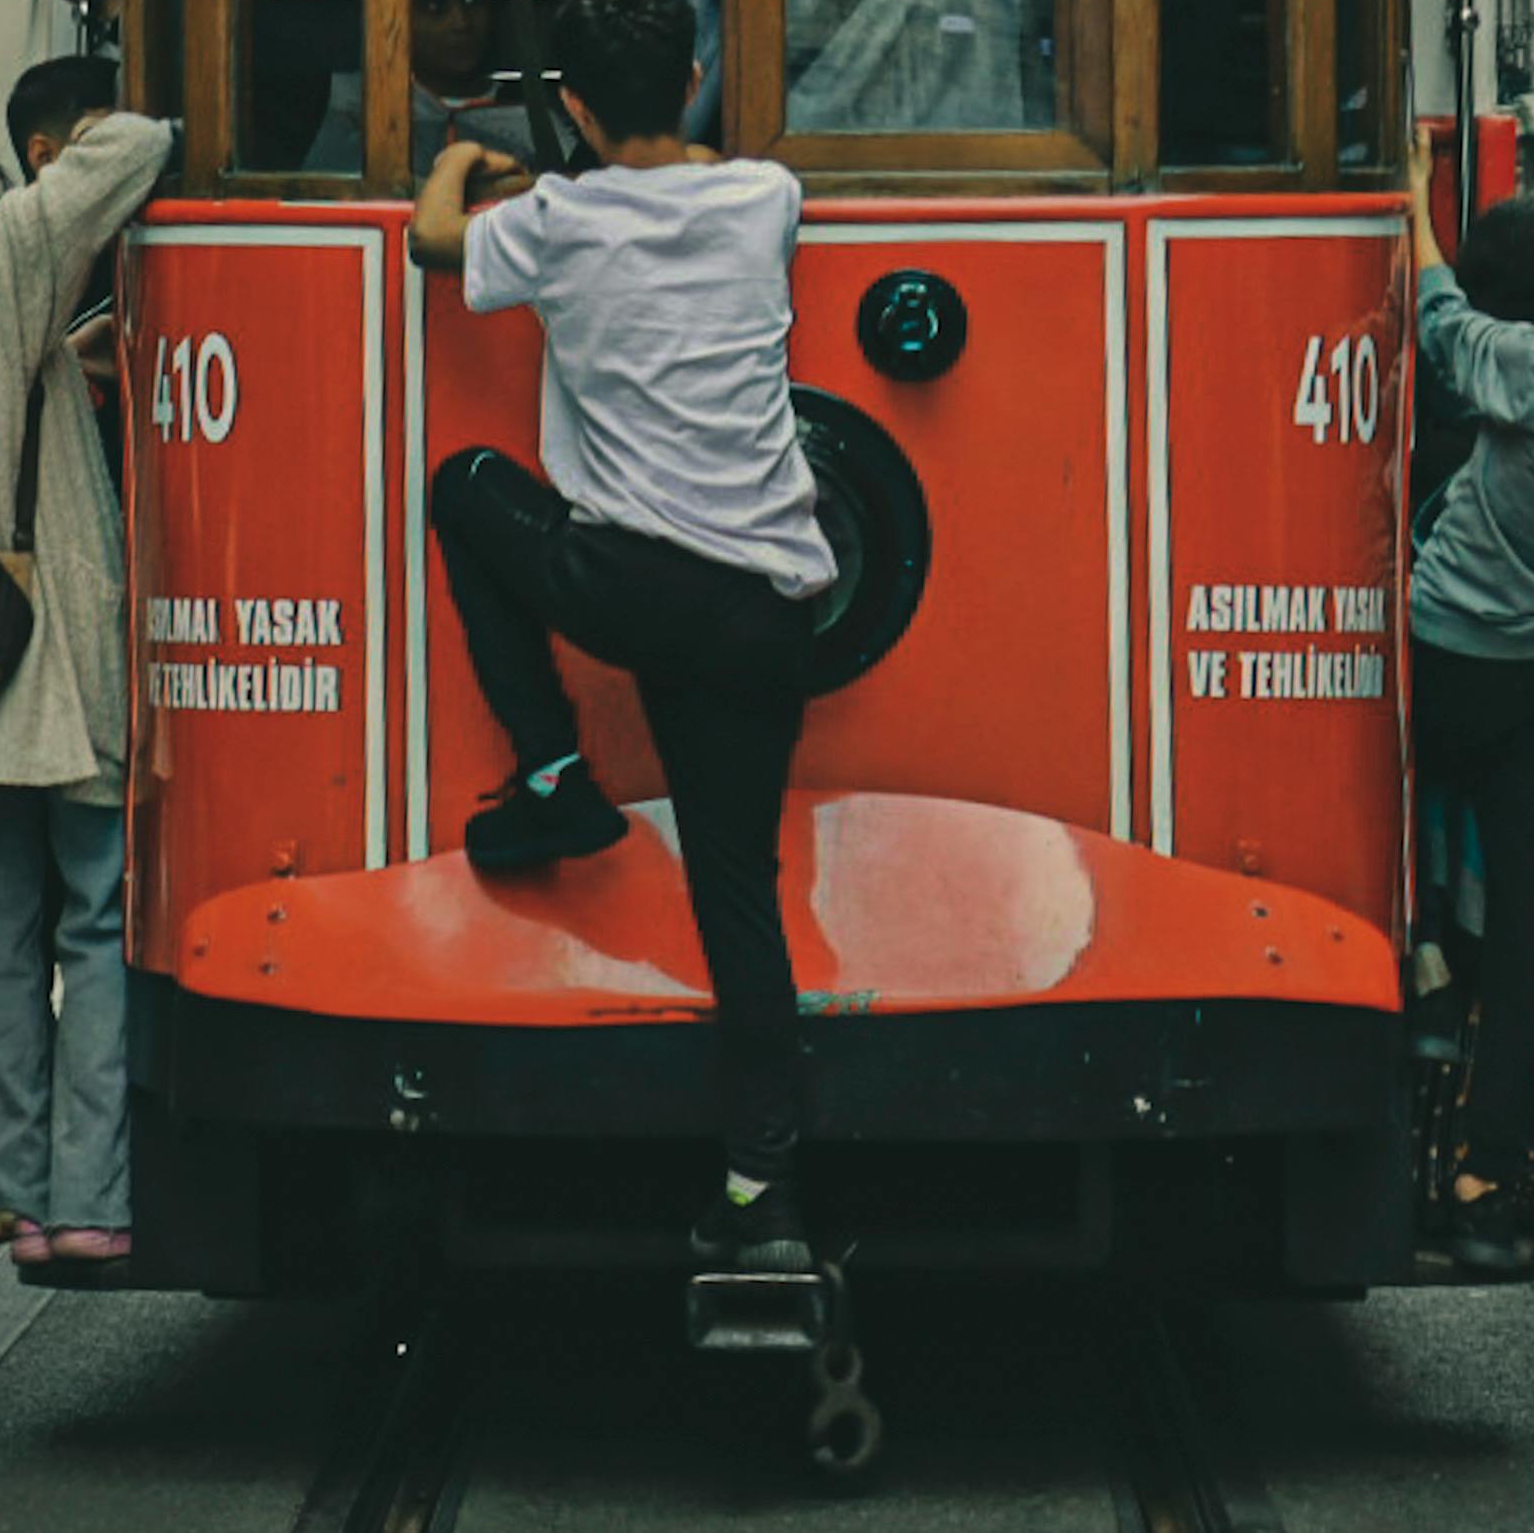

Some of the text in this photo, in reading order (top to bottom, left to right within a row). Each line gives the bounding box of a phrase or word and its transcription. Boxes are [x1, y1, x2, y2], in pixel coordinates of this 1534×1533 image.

[151, 331, 237, 443] 410
[1294, 333, 1378, 444] 410
[235, 598, 342, 645] YASAK
[1186, 584, 1327, 633] ASILMAK
[163, 655, 340, 712] TEHLİKELİDİR
[1187, 650, 1227, 698] VE
